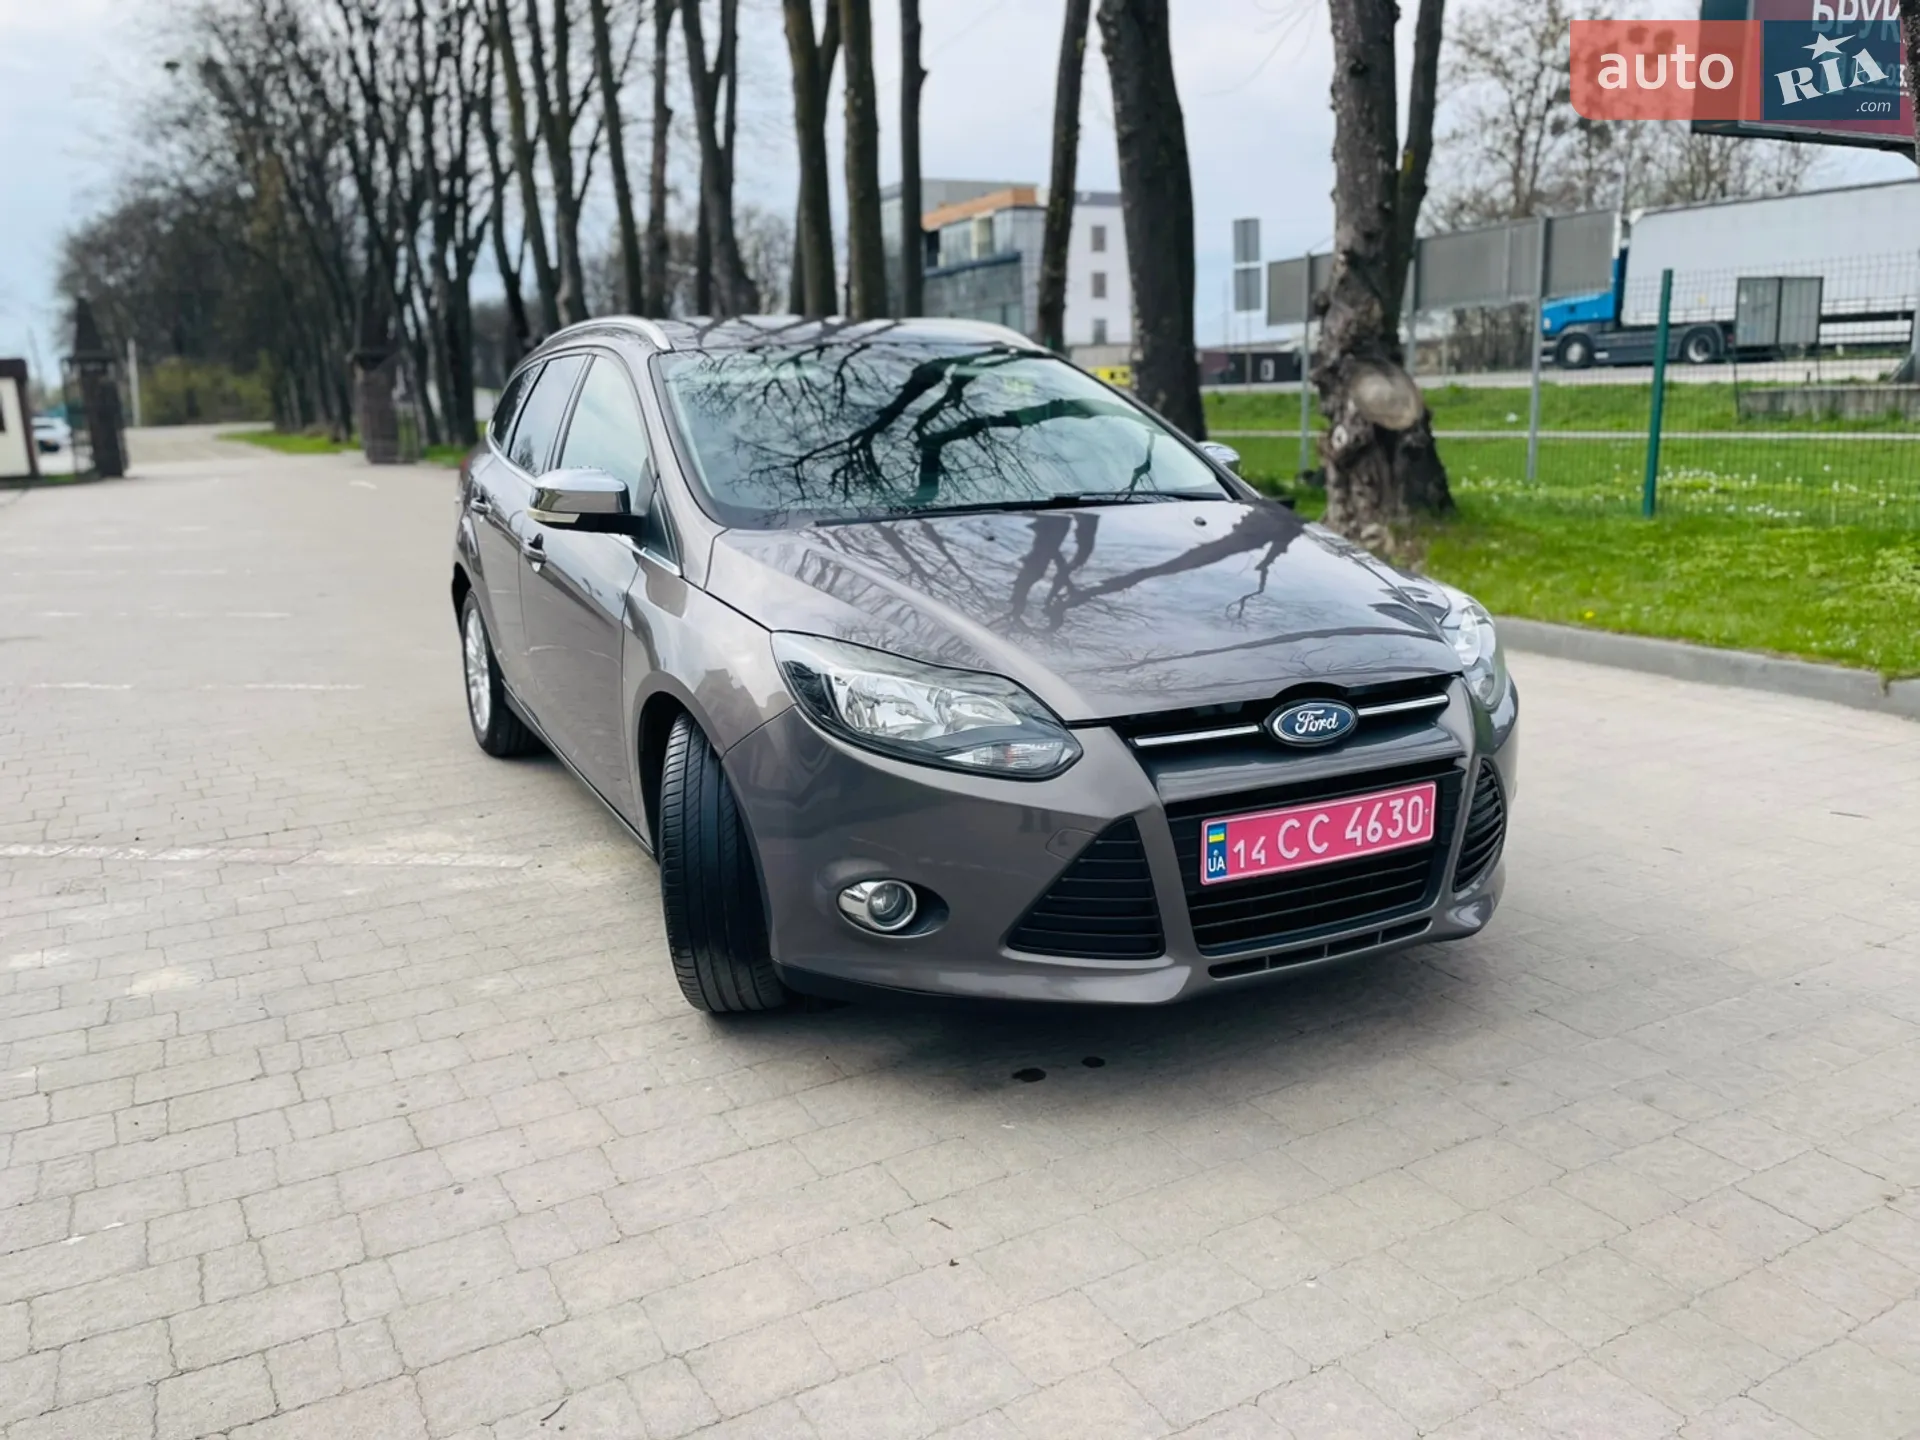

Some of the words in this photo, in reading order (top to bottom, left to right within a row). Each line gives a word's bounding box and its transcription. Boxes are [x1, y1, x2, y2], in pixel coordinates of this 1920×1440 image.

[1811, 0, 1904, 43] БРУК
[1295, 709, 1339, 734] Ford
[1232, 836, 1267, 868] 14
[1278, 814, 1330, 859] CC
[1345, 795, 1424, 847] 4630
[1208, 856, 1226, 872] UA
